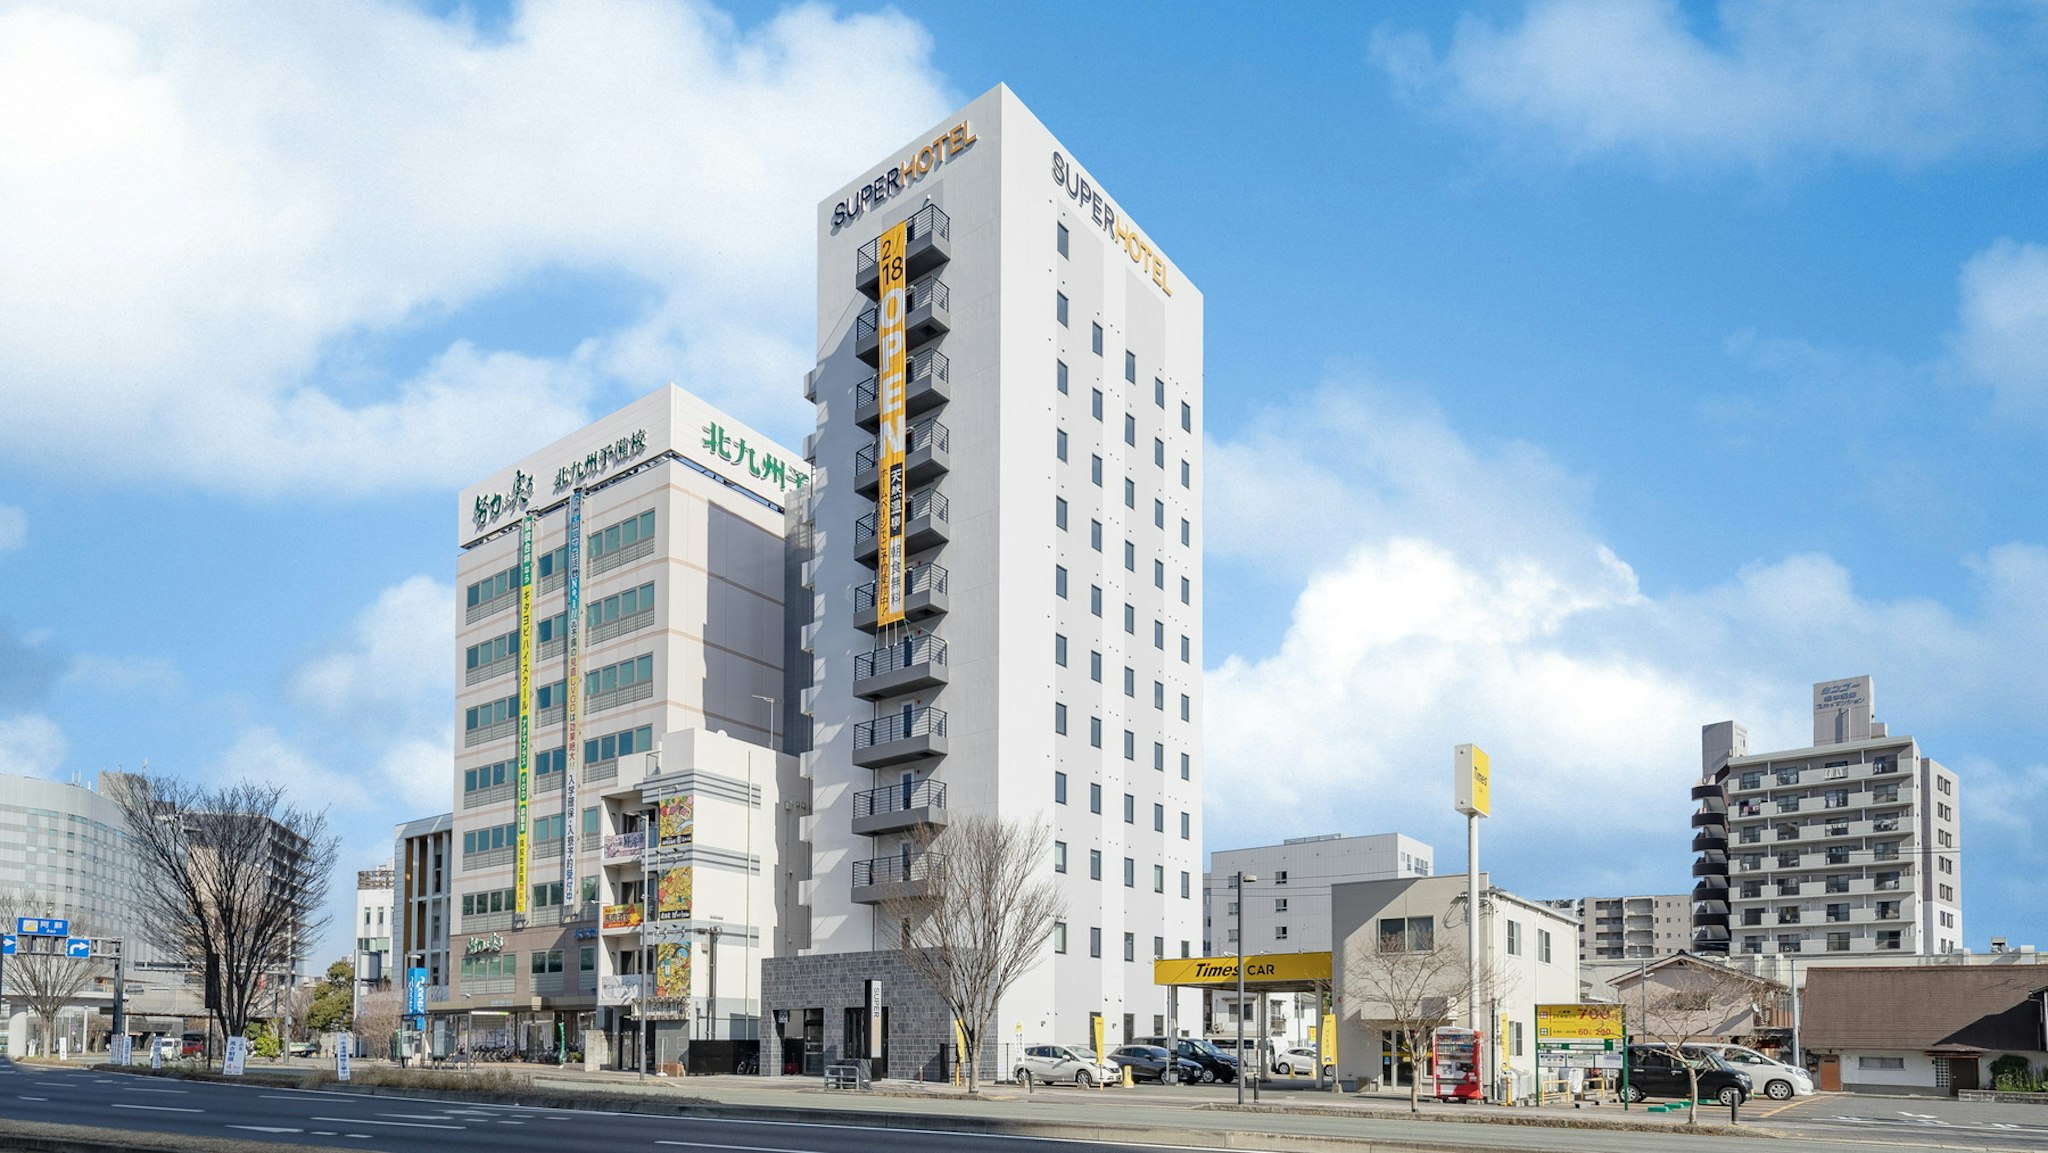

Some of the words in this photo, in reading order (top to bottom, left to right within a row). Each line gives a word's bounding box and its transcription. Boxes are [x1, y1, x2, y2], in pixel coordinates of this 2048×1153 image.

[880, 288, 905, 460] OPEN
[555, 429, 647, 487] 北九州予備校
[891, 468, 902, 532] 天然温泉
[522, 591, 530, 710] キタヨビハイスクール
[1196, 963, 1240, 977] Times
[1247, 964, 1275, 976] CAR
